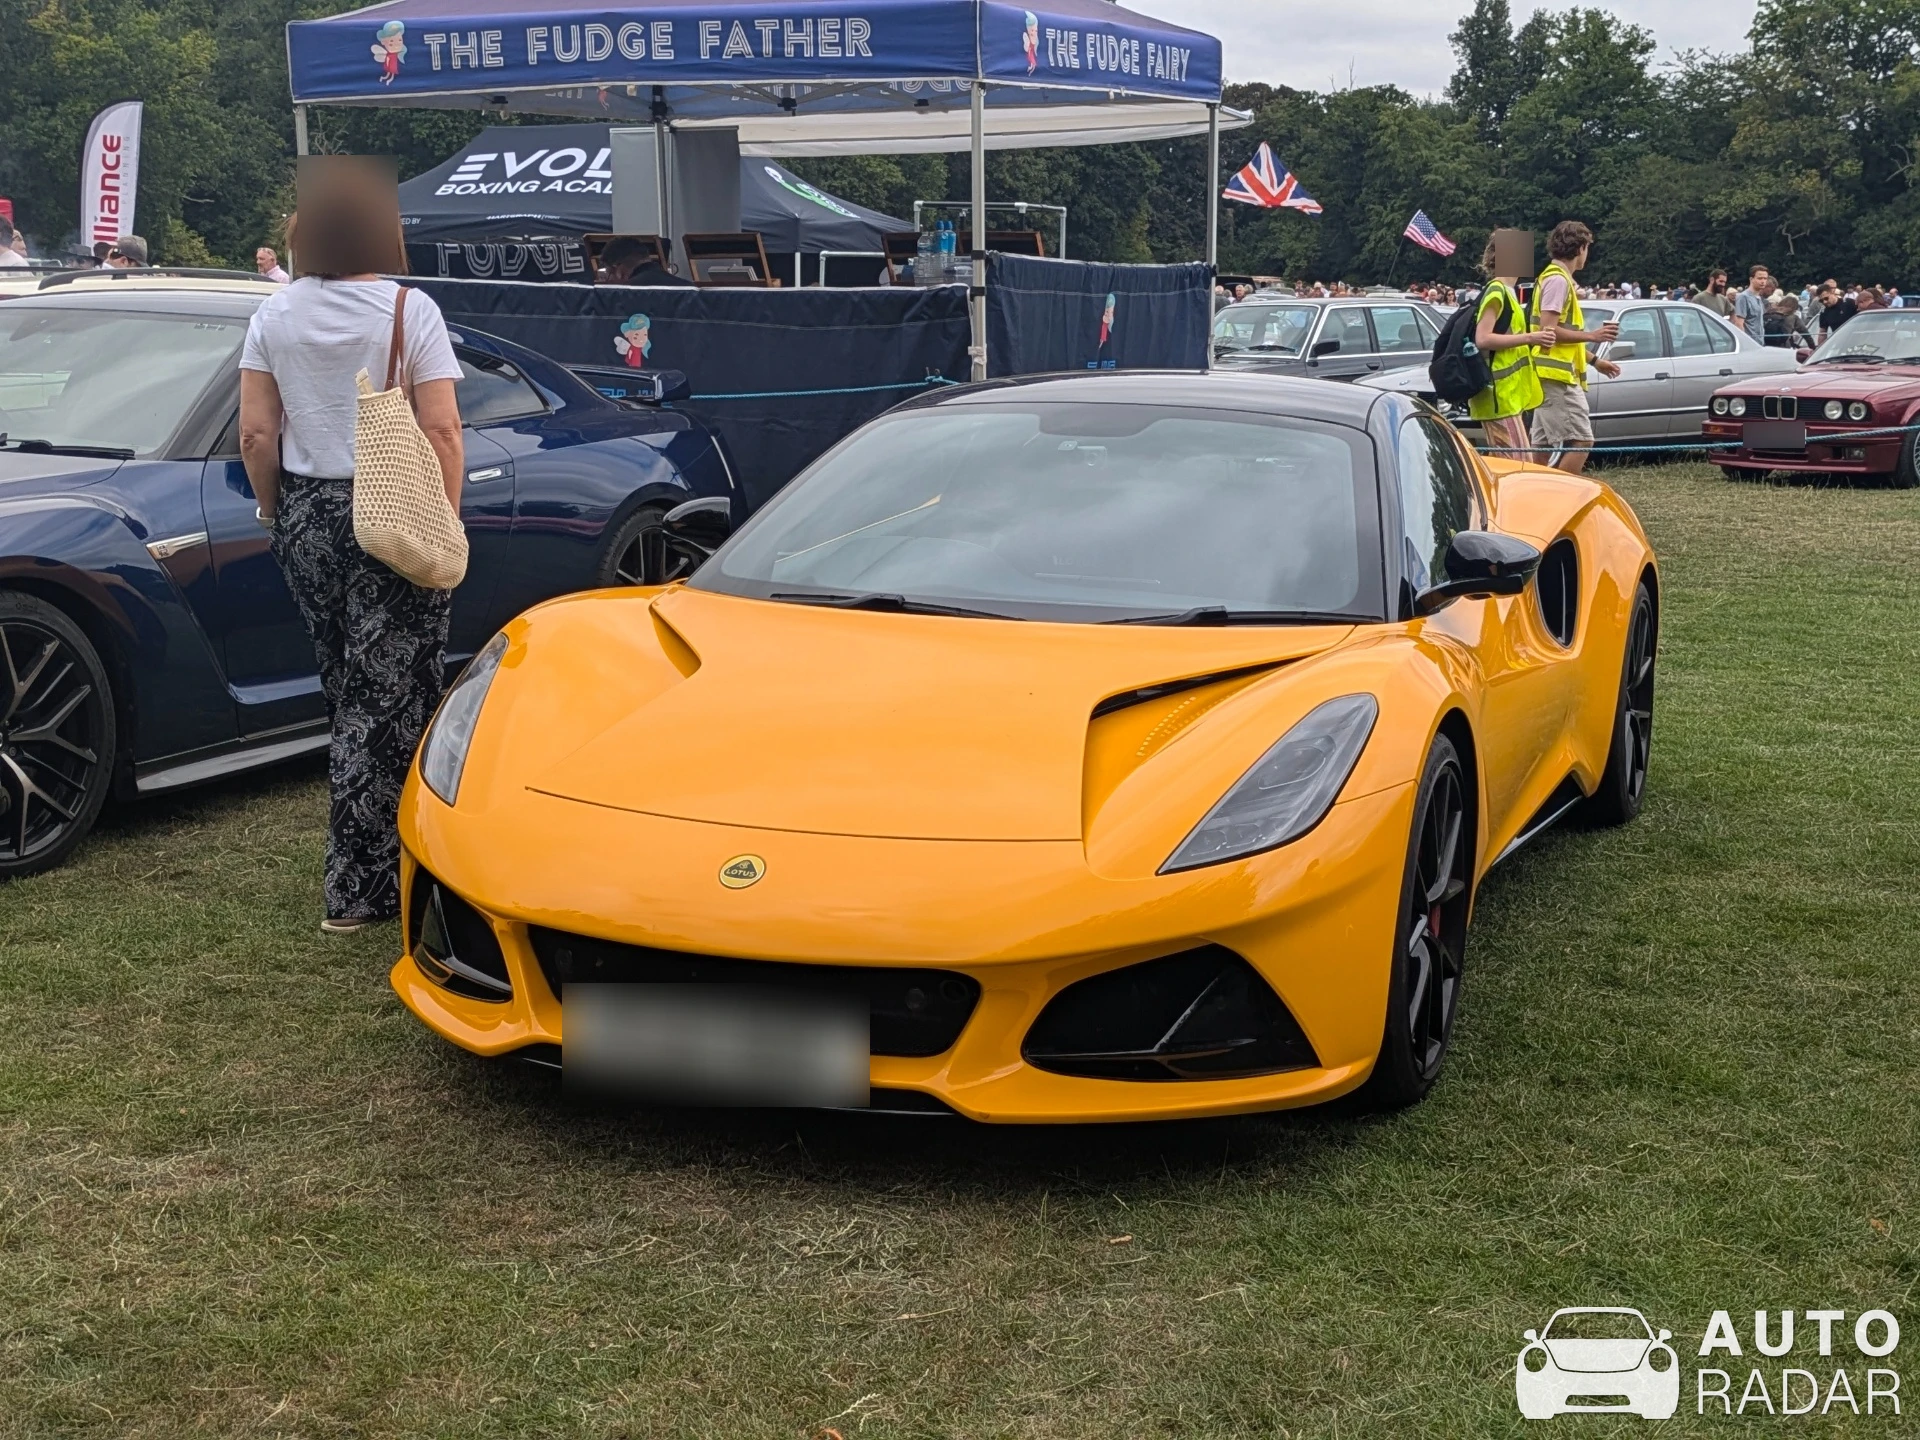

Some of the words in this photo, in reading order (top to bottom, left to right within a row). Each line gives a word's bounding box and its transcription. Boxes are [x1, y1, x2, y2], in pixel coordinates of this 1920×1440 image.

[424, 30, 504, 71] THE
[526, 22, 675, 65] FUDGE
[699, 17, 873, 60] FATHER
[1045, 28, 1080, 69] THE
[1086, 33, 1140, 75] FUDGE
[1147, 42, 1191, 82] FAIRY
[93, 134, 121, 243] lliance
[434, 180, 540, 196] BOXING
[411, 217, 422, 225] BY
[725, 868, 756, 878] LOTUS
